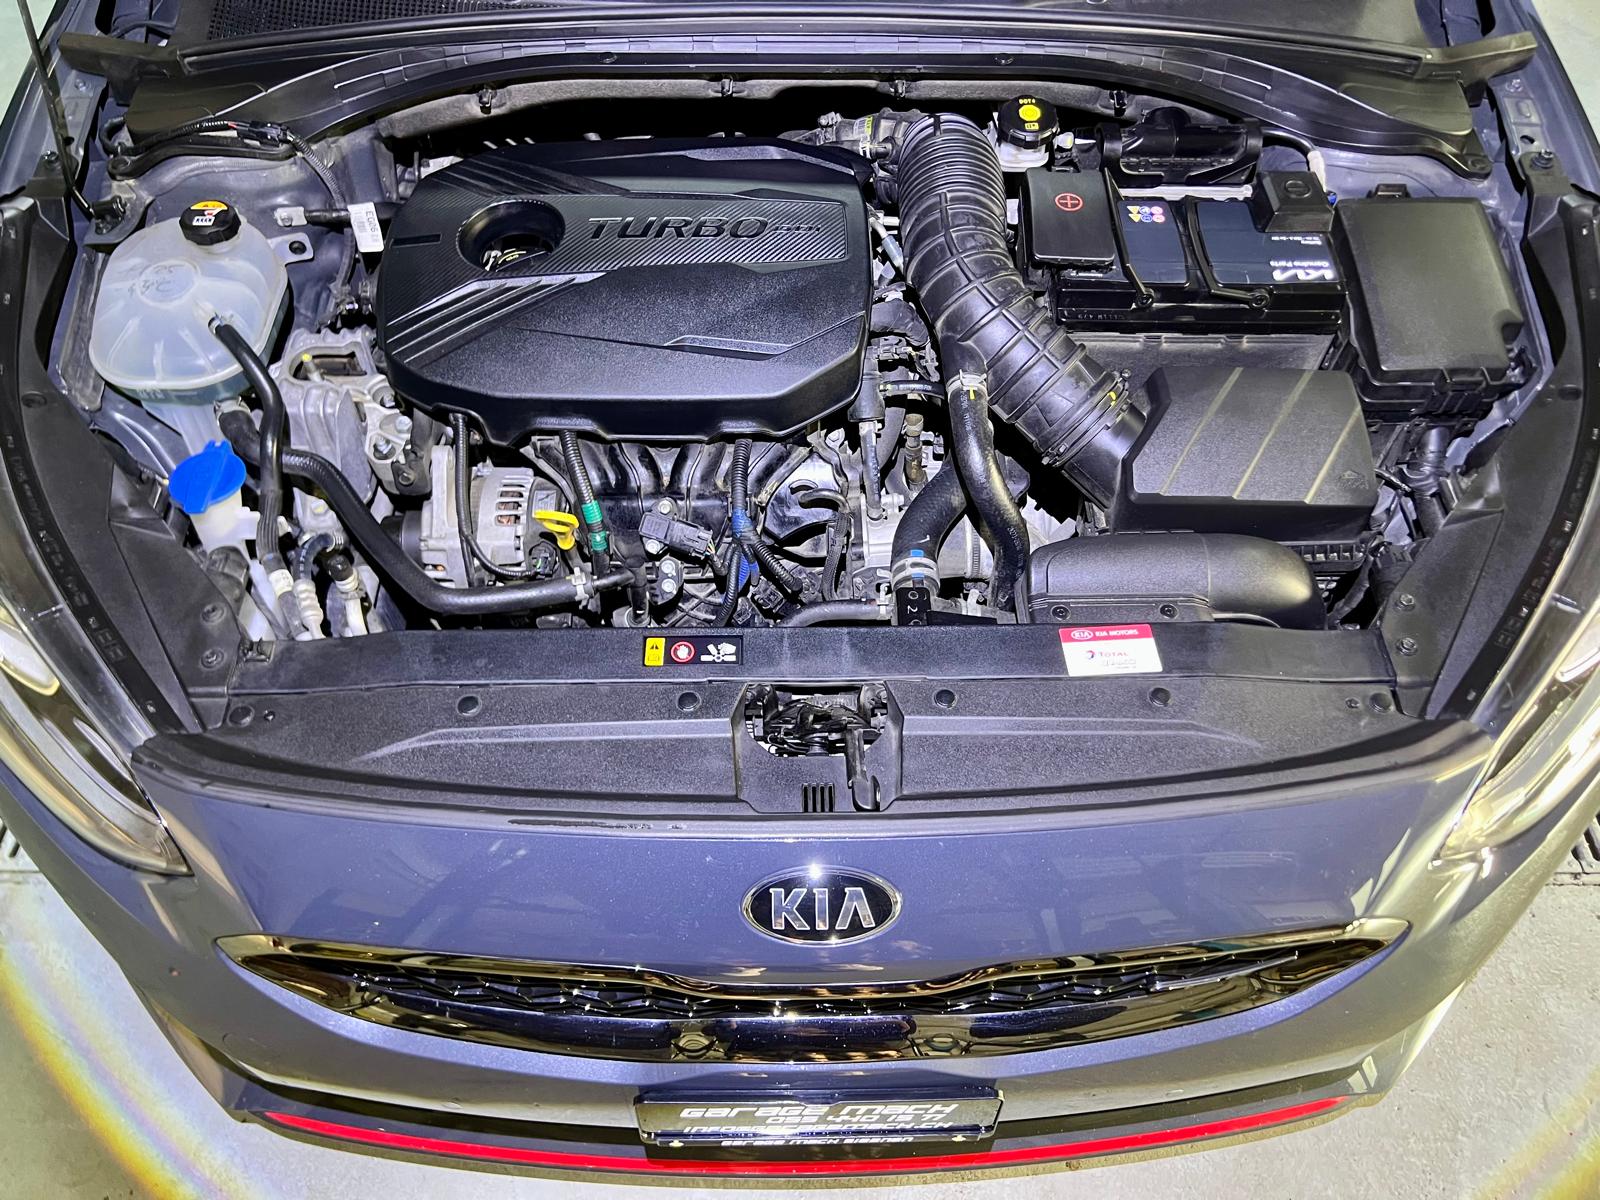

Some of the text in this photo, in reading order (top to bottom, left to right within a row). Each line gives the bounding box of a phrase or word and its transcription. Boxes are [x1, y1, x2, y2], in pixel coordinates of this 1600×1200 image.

[588, 216, 769, 239] TURBO
[1109, 628, 1139, 636] MOTORS
[769, 887, 876, 930] KIA
[766, 1113, 946, 1124] 055 440 15 77
